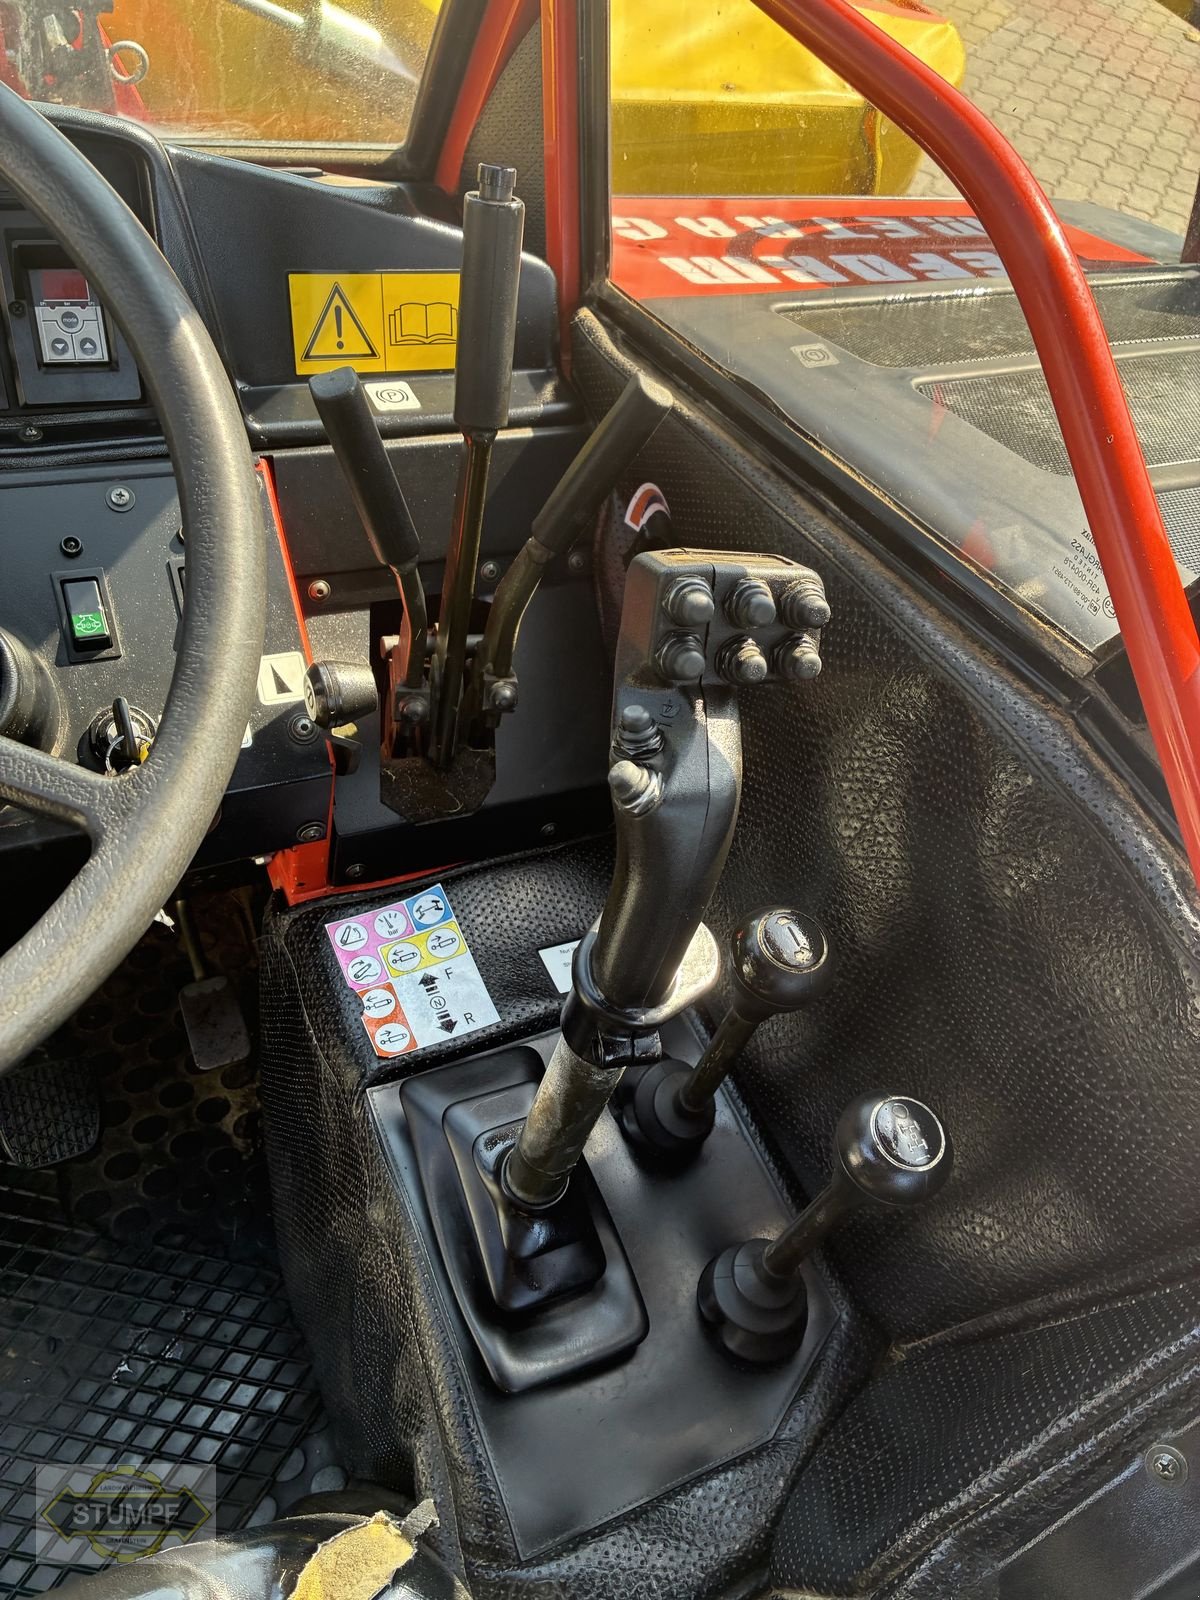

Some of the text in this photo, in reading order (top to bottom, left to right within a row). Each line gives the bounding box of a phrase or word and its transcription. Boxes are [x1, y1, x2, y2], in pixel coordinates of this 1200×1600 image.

[659, 252, 1008, 285] EFORM
[387, 392, 396, 400] P
[387, 927, 400, 937] bar
[445, 967, 454, 980] F
[464, 1013, 476, 1025] R
